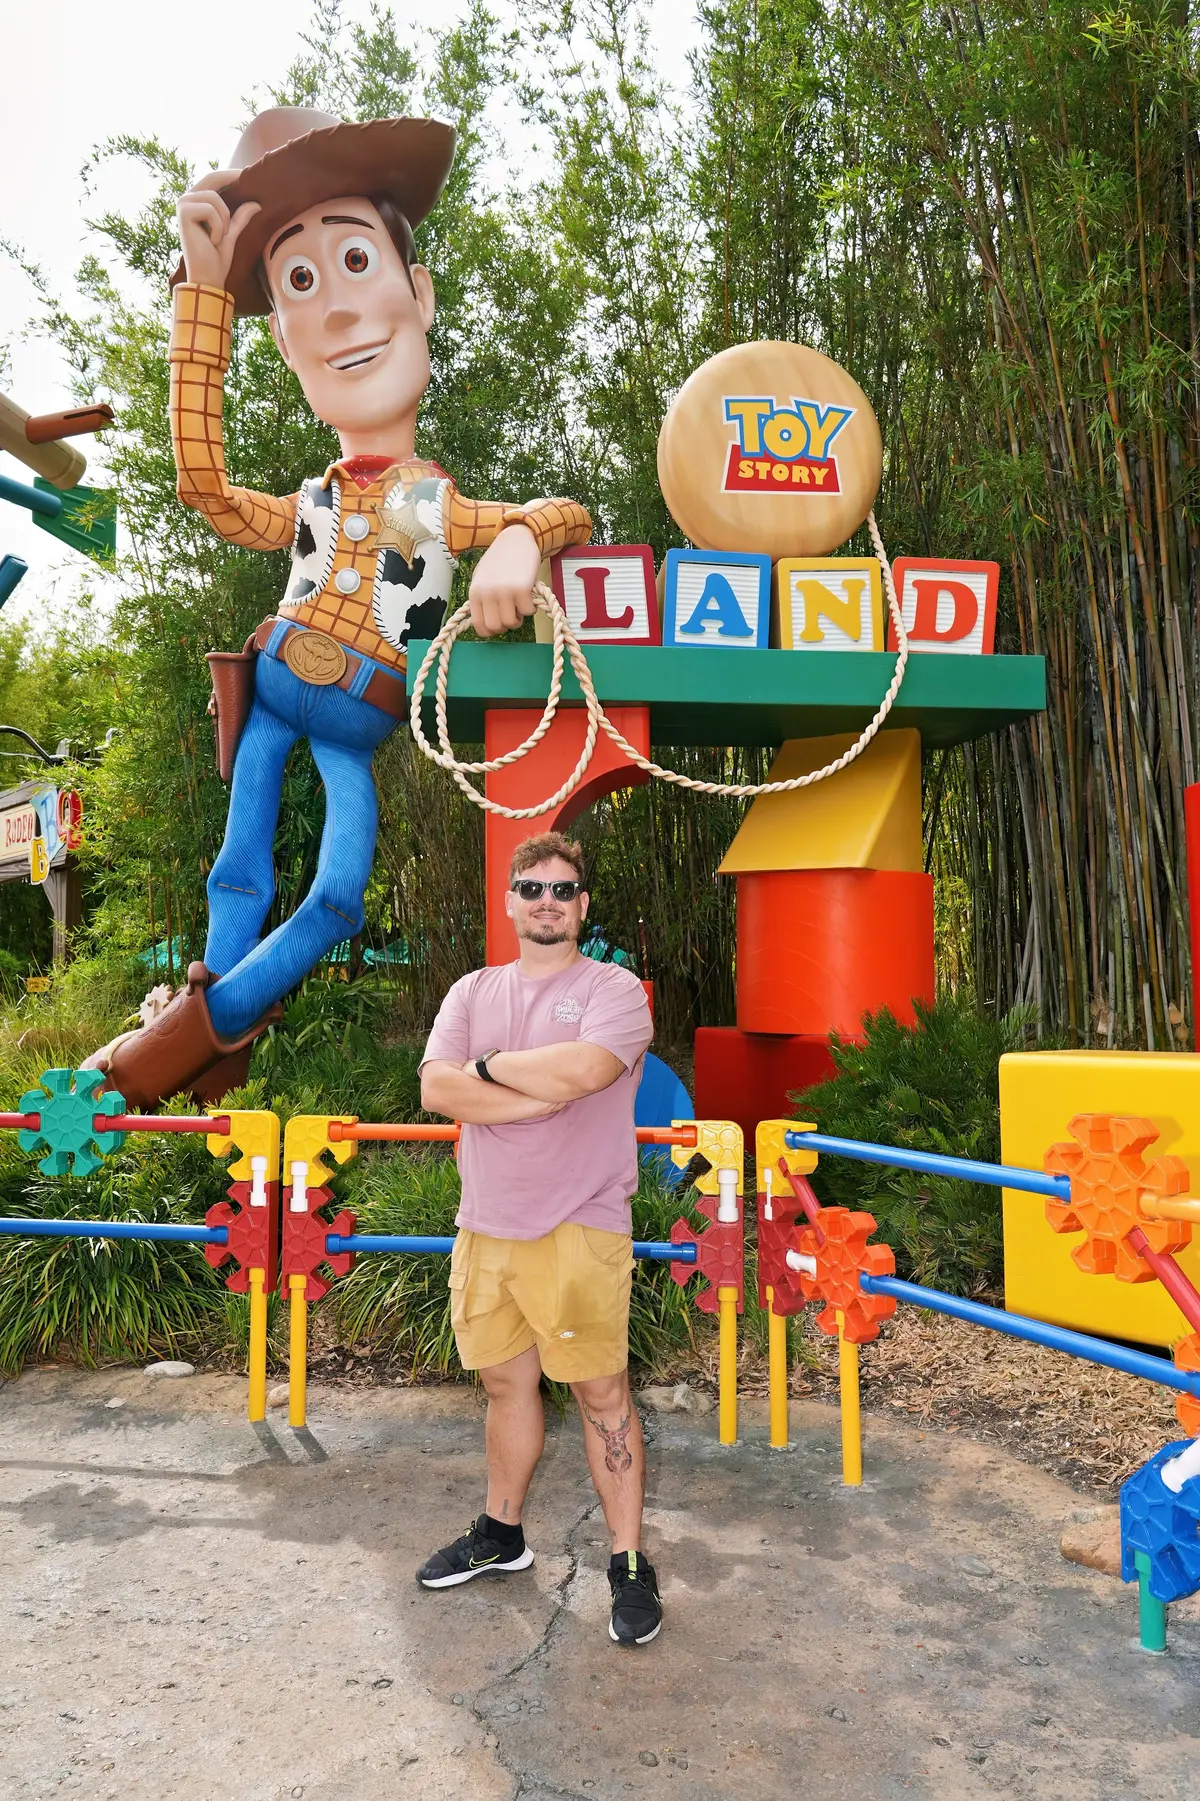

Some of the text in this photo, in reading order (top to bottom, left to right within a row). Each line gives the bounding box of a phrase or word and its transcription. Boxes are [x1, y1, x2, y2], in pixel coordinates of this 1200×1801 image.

[724, 398, 854, 463] TOY
[738, 460, 829, 485] STORY
[574, 566, 979, 643] LAND
[5, 813, 34, 848] RODEO
